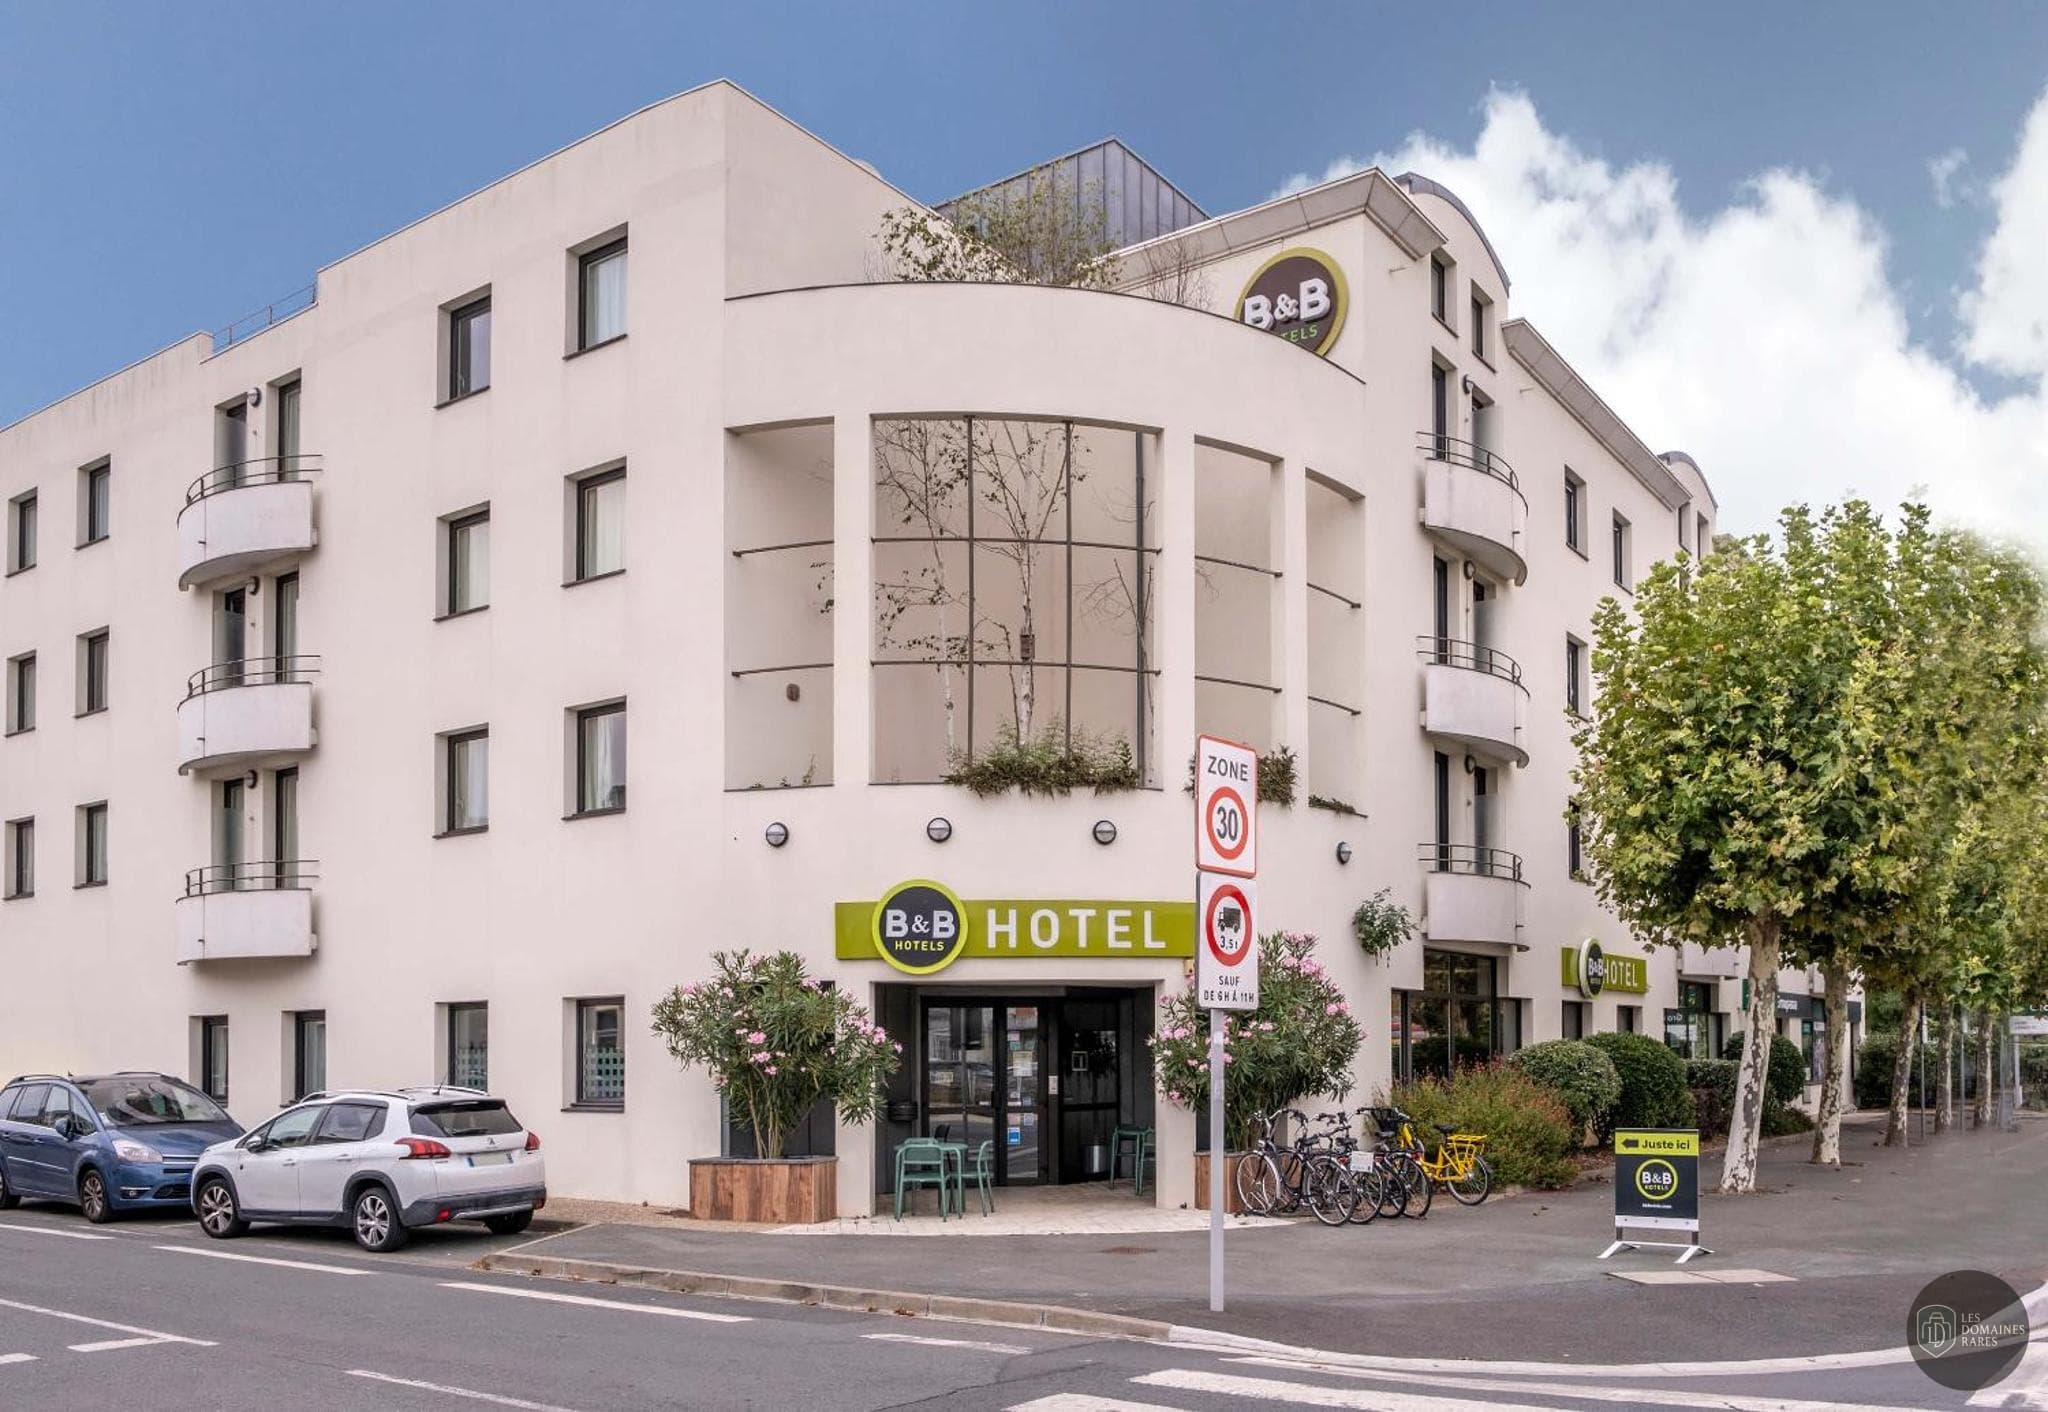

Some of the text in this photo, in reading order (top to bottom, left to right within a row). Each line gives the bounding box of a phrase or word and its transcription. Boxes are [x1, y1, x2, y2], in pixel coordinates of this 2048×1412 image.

[1244, 278, 1331, 330] B&B
[1207, 755, 1249, 782] ZONE
[1216, 806, 1239, 841] 30
[885, 909, 956, 939] B&B
[986, 908, 1167, 949] HOTEL
[895, 940, 945, 951] HOTELS
[1218, 975, 1240, 987] SAUF
[1203, 990, 1214, 1001] DE
[1641, 1139, 1690, 1150] Juste ici
[1641, 1171, 1673, 1185] B&B
